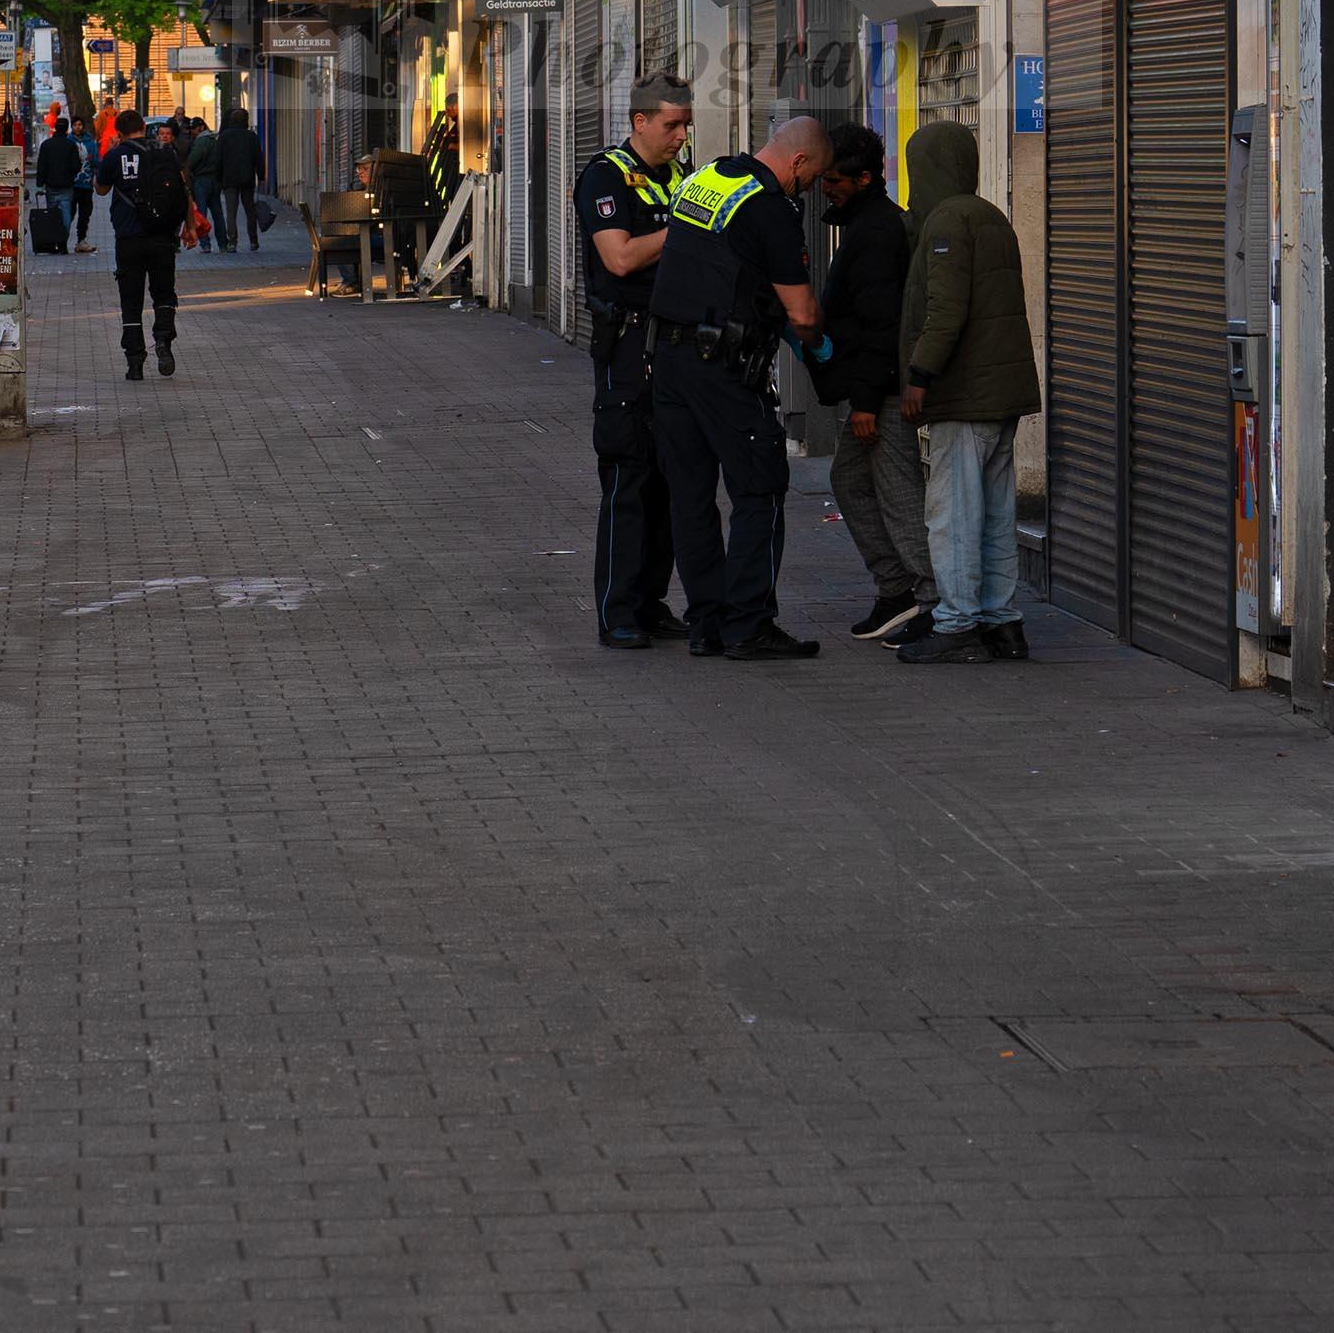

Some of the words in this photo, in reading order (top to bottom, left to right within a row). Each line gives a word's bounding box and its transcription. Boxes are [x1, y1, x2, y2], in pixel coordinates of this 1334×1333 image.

[298, 38, 331, 47] BERBER
[121, 154, 140, 175] H
[683, 182, 724, 210] POLIZEI
